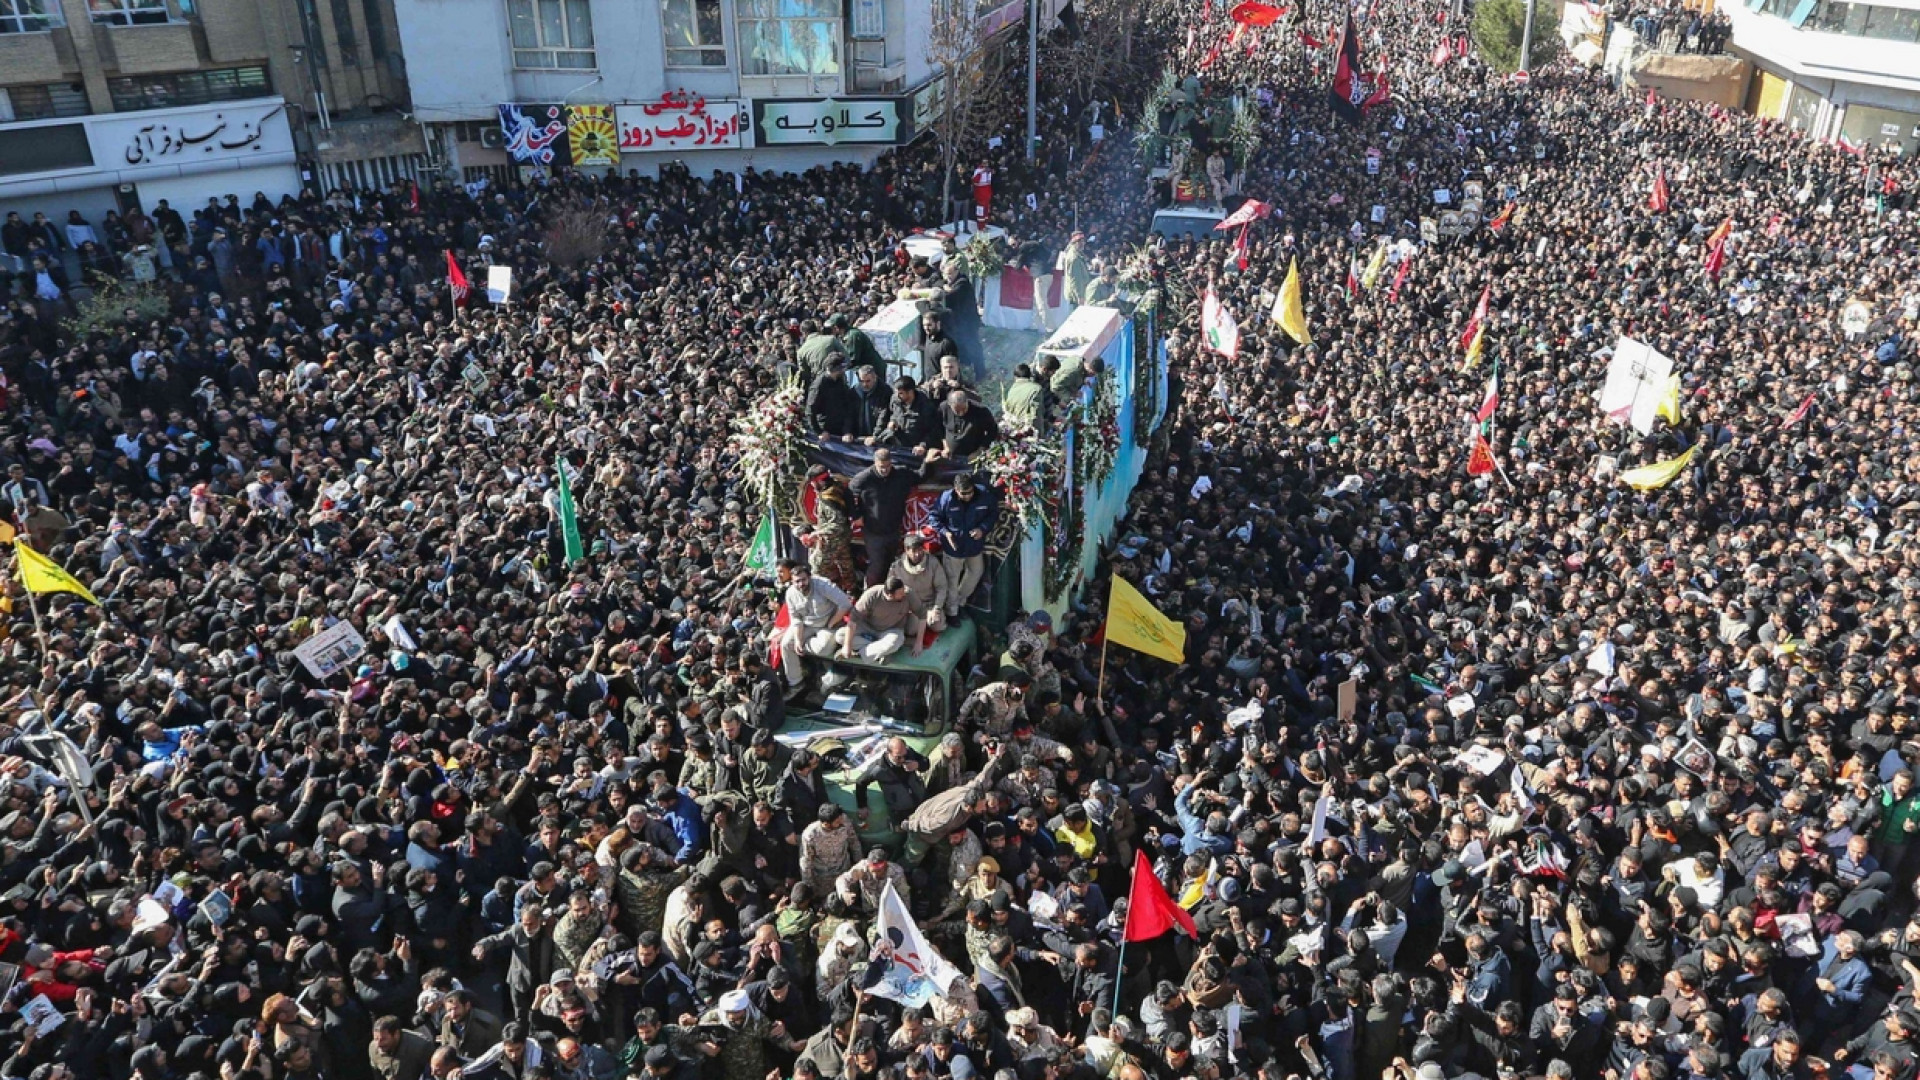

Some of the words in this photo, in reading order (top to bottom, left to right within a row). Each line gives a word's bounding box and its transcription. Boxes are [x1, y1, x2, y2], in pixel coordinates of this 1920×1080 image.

[644, 88, 705, 117] پزشکی
[220, 106, 282, 150] کیف
[620, 121, 653, 147] روز
[655, 116, 695, 145] طب
[775, 109, 886, 133] کلاویه
